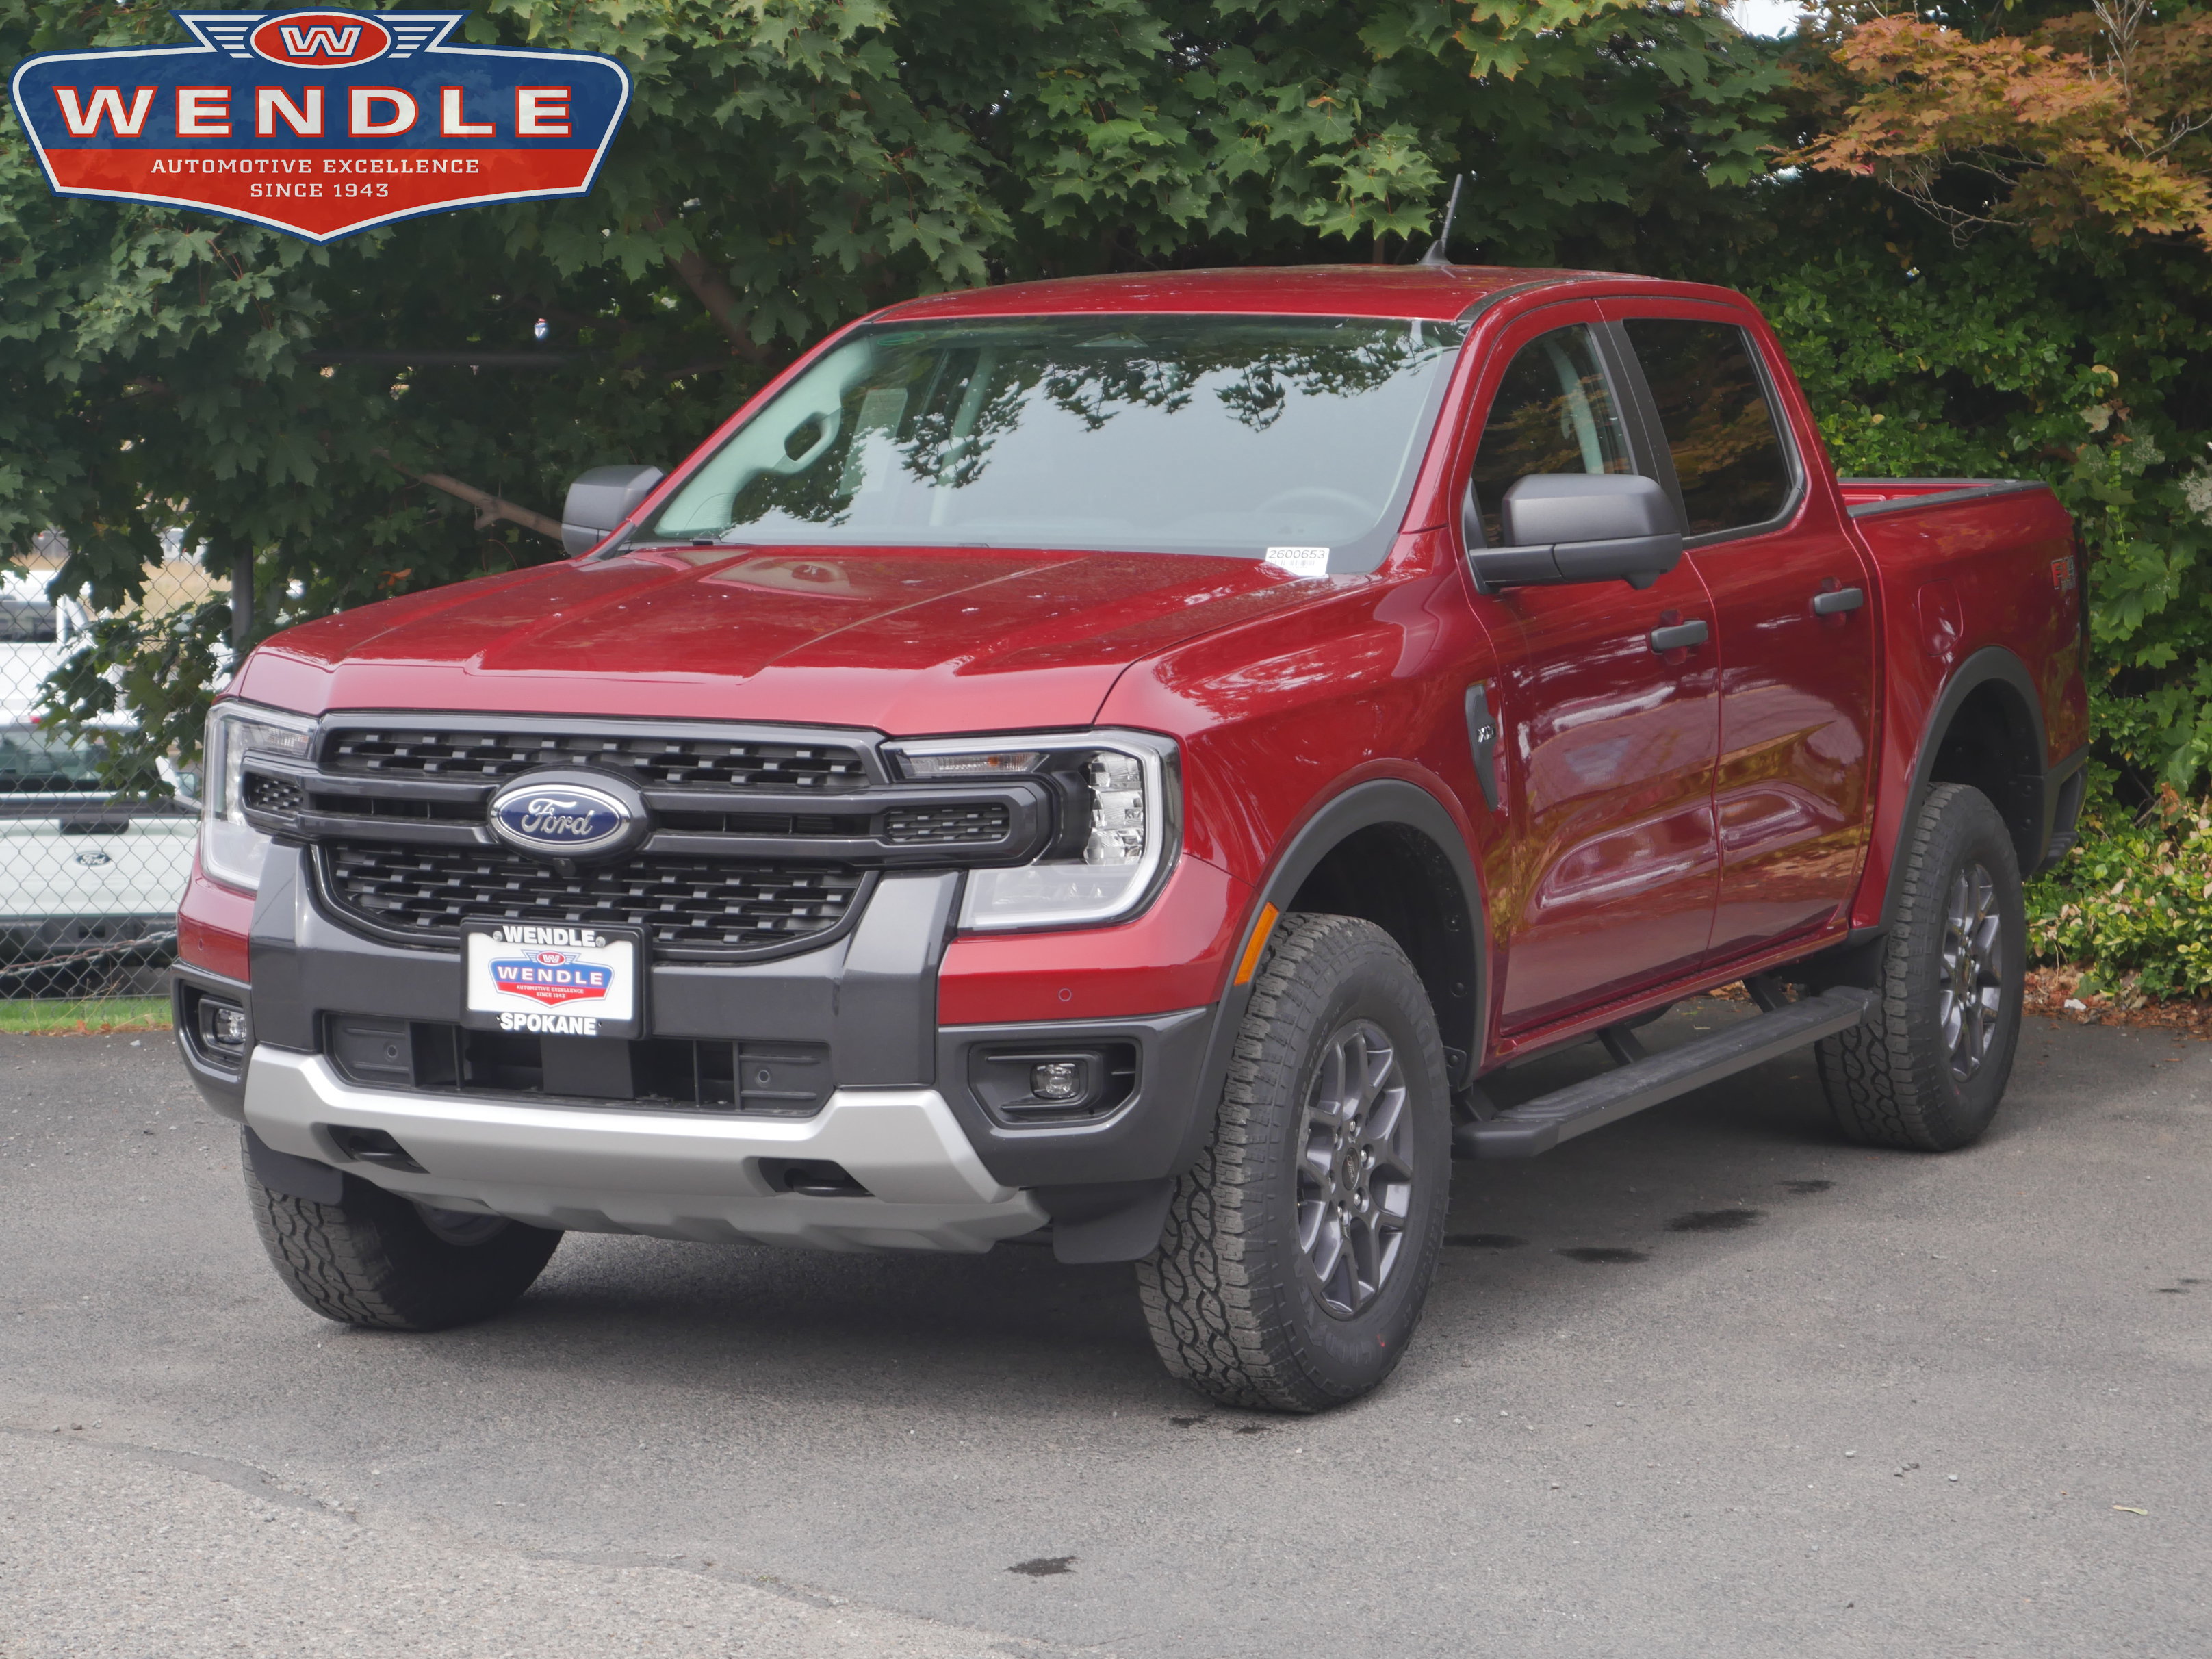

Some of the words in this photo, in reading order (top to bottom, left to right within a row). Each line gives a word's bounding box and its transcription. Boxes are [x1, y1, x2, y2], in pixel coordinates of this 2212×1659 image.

[1268, 549, 1325, 559] 2600653
[521, 797, 594, 836] Ford
[80, 853, 105, 864] Ford
[503, 925, 596, 948] WENDLE
[497, 966, 603, 986] WENDLE
[500, 1012, 596, 1036] SPOKANE
